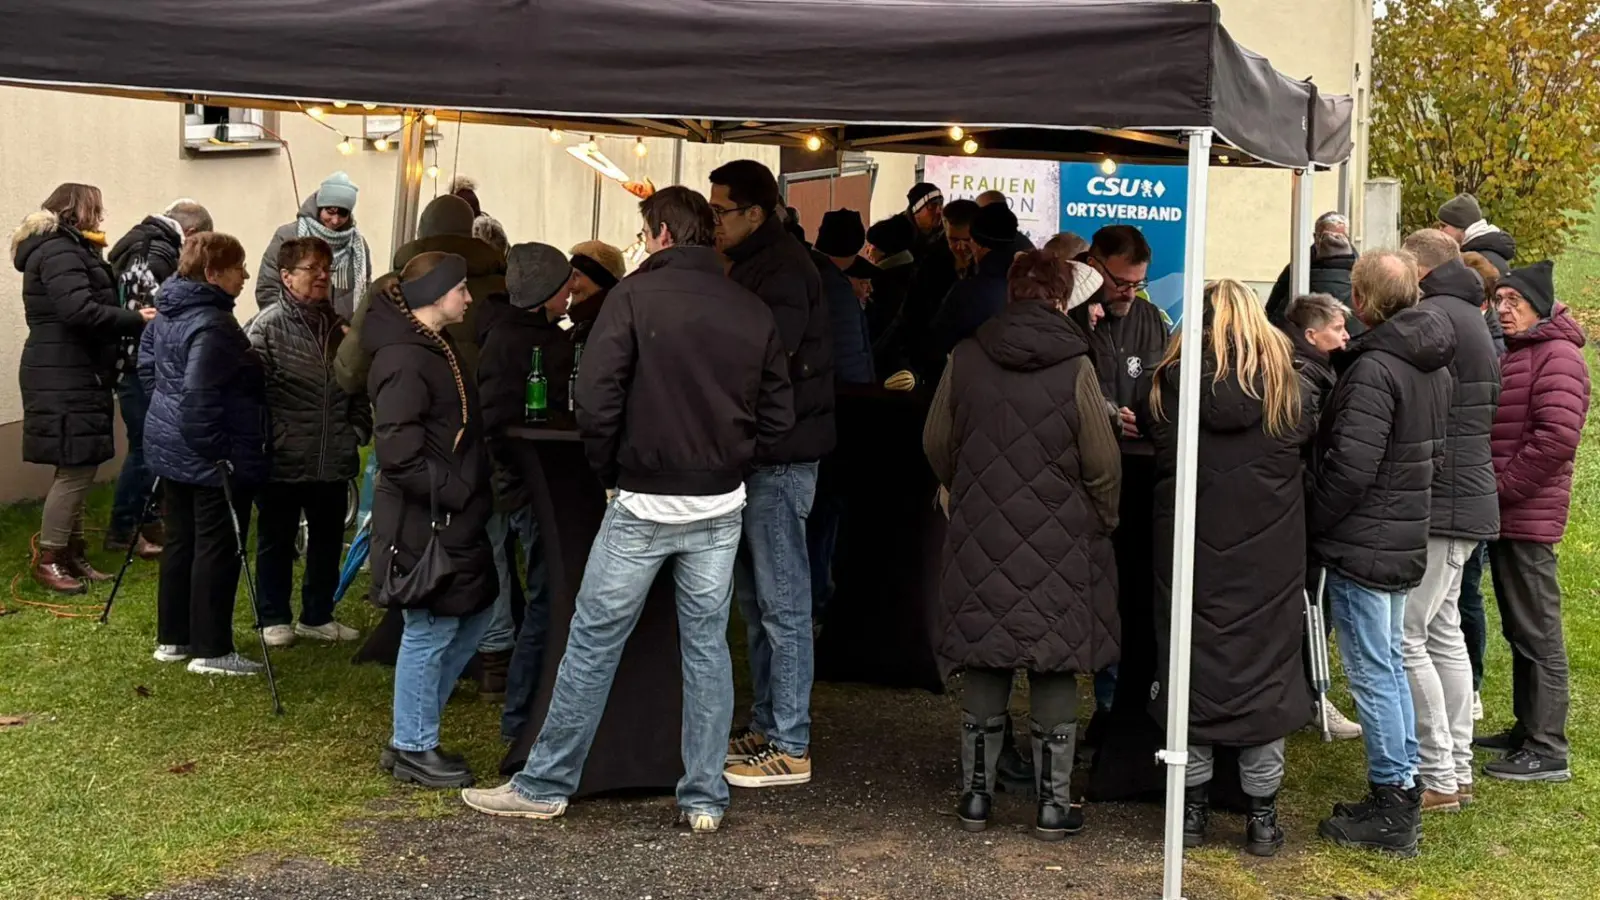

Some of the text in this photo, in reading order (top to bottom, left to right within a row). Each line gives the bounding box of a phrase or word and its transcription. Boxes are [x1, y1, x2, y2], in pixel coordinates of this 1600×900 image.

[950, 174, 1036, 194] FRAUEN
[1086, 176, 1141, 197] CSU
[1066, 202, 1182, 221] ORTSVERBAND
